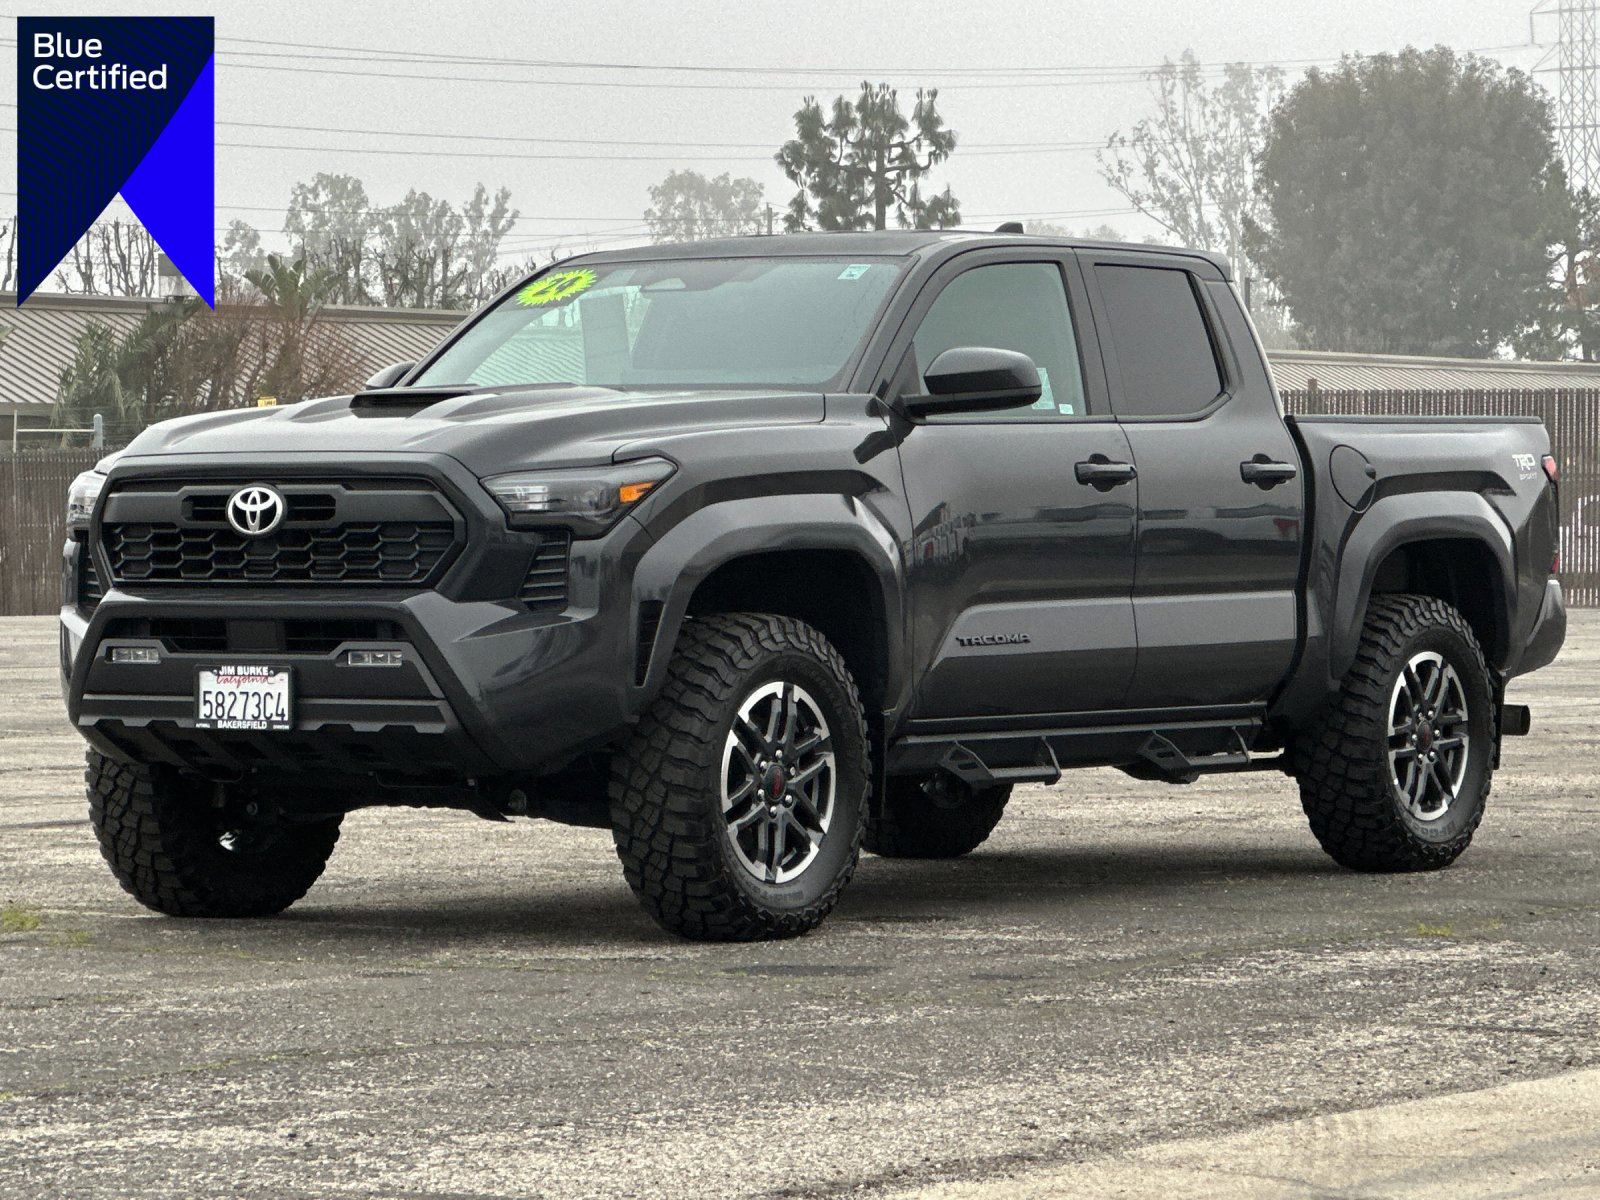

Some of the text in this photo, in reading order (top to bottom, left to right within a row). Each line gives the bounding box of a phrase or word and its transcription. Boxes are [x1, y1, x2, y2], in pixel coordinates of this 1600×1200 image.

[1512, 453, 1536, 471] TRD
[956, 633, 1031, 647] TACOMA
[219, 666, 268, 676] JIM BURKE
[203, 690, 285, 720] 58273C4
[217, 720, 267, 729] BAKERSFIELD
